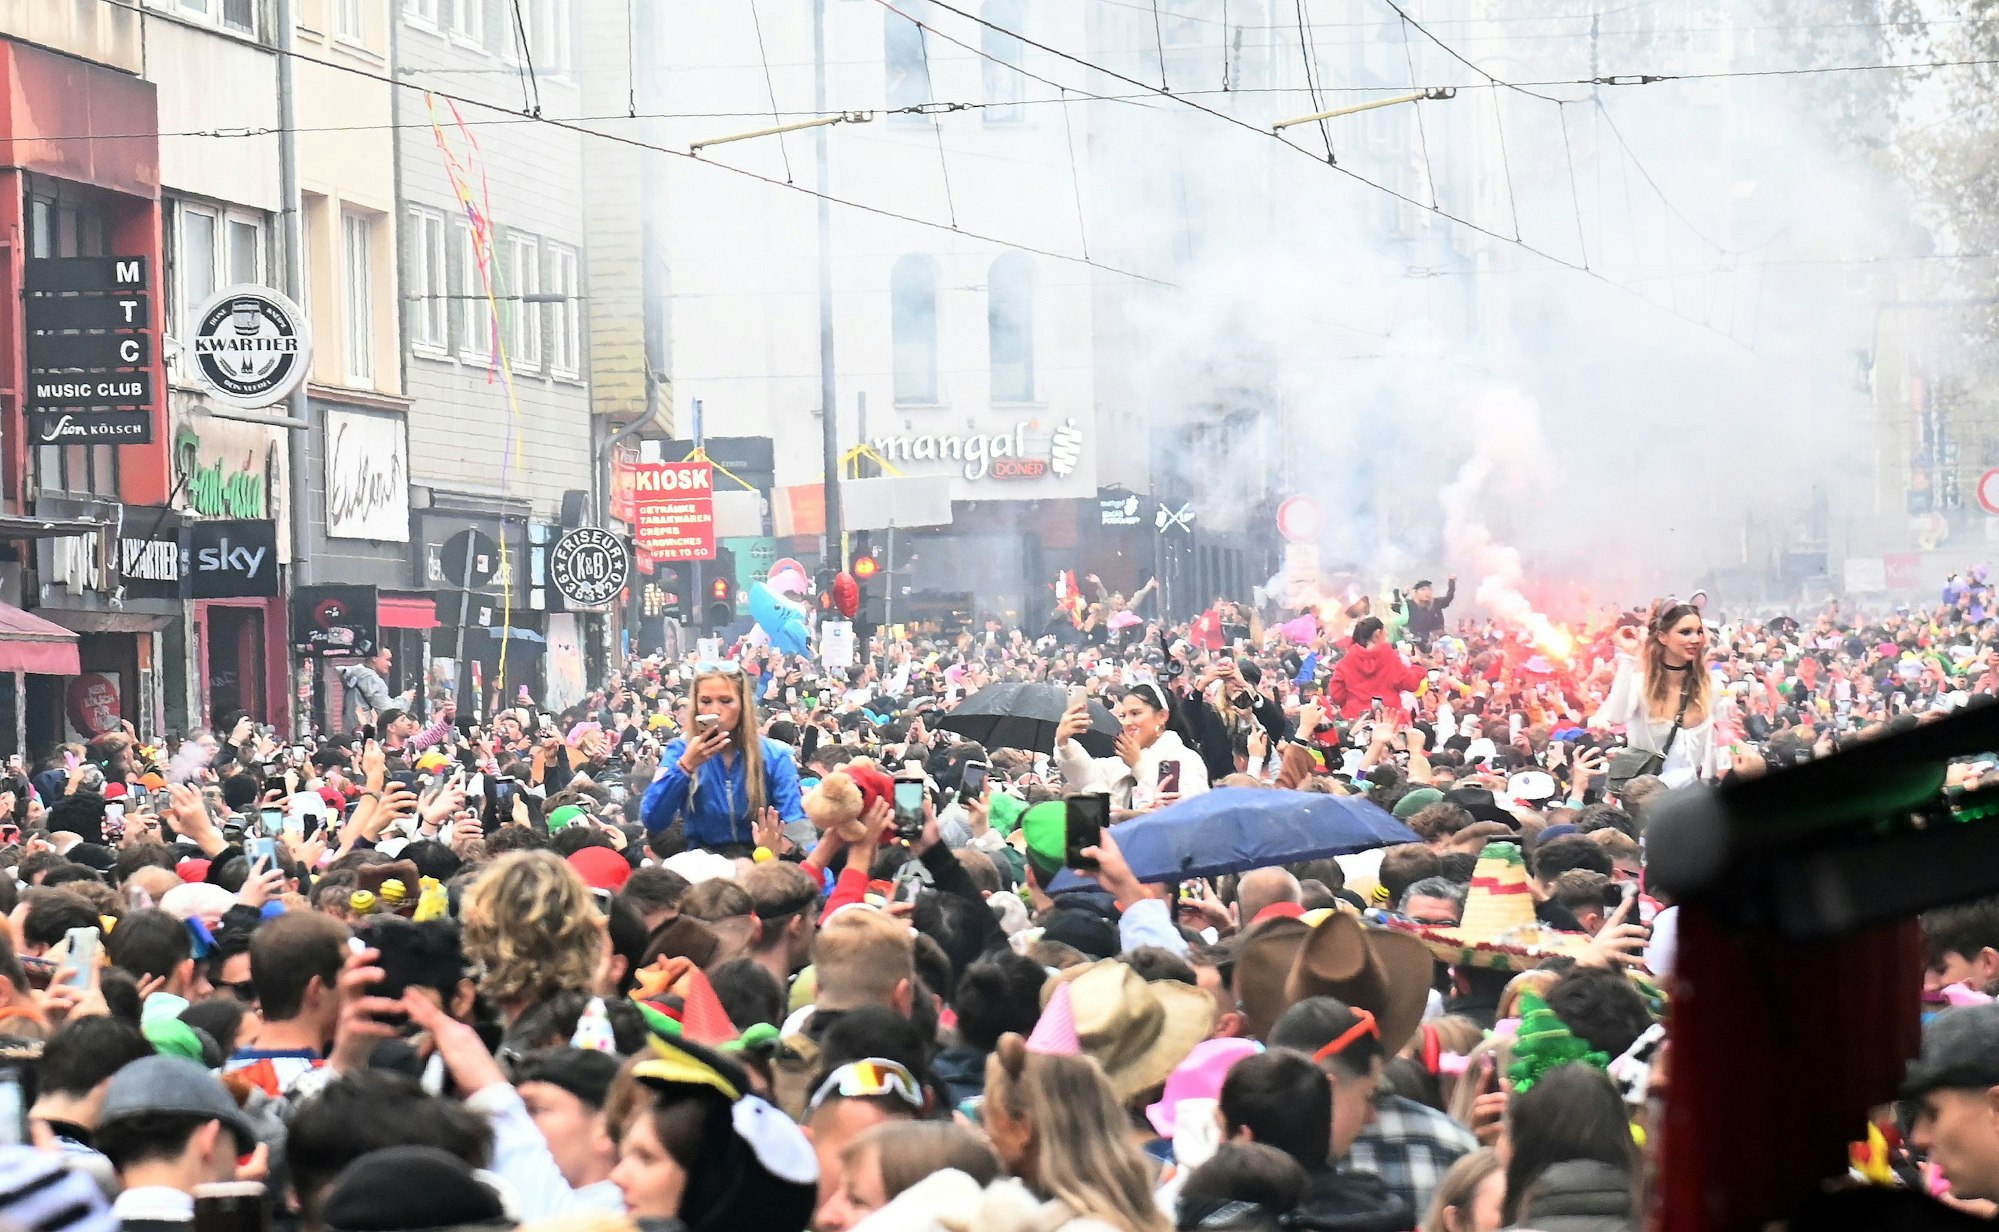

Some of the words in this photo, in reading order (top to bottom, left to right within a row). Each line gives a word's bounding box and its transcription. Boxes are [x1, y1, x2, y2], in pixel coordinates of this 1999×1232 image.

[116, 261, 139, 283] M
[119, 301, 138, 323] T
[120, 340, 140, 362] C
[195, 338, 298, 351] KWARTIER
[37, 384, 91, 398] MUSIC
[97, 382, 142, 397] CLUB
[41, 415, 87, 441] Sion
[90, 423, 142, 435] KÖLSCH
[873, 421, 1029, 480] mangal
[636, 468, 709, 491] KIOSK
[557, 530, 622, 560] FRISEUR
[679, 548, 692, 556] TO
[694, 547, 708, 556] GO
[121, 538, 178, 581] KWARTIER
[198, 537, 266, 578] sky
[576, 551, 604, 580] K&B
